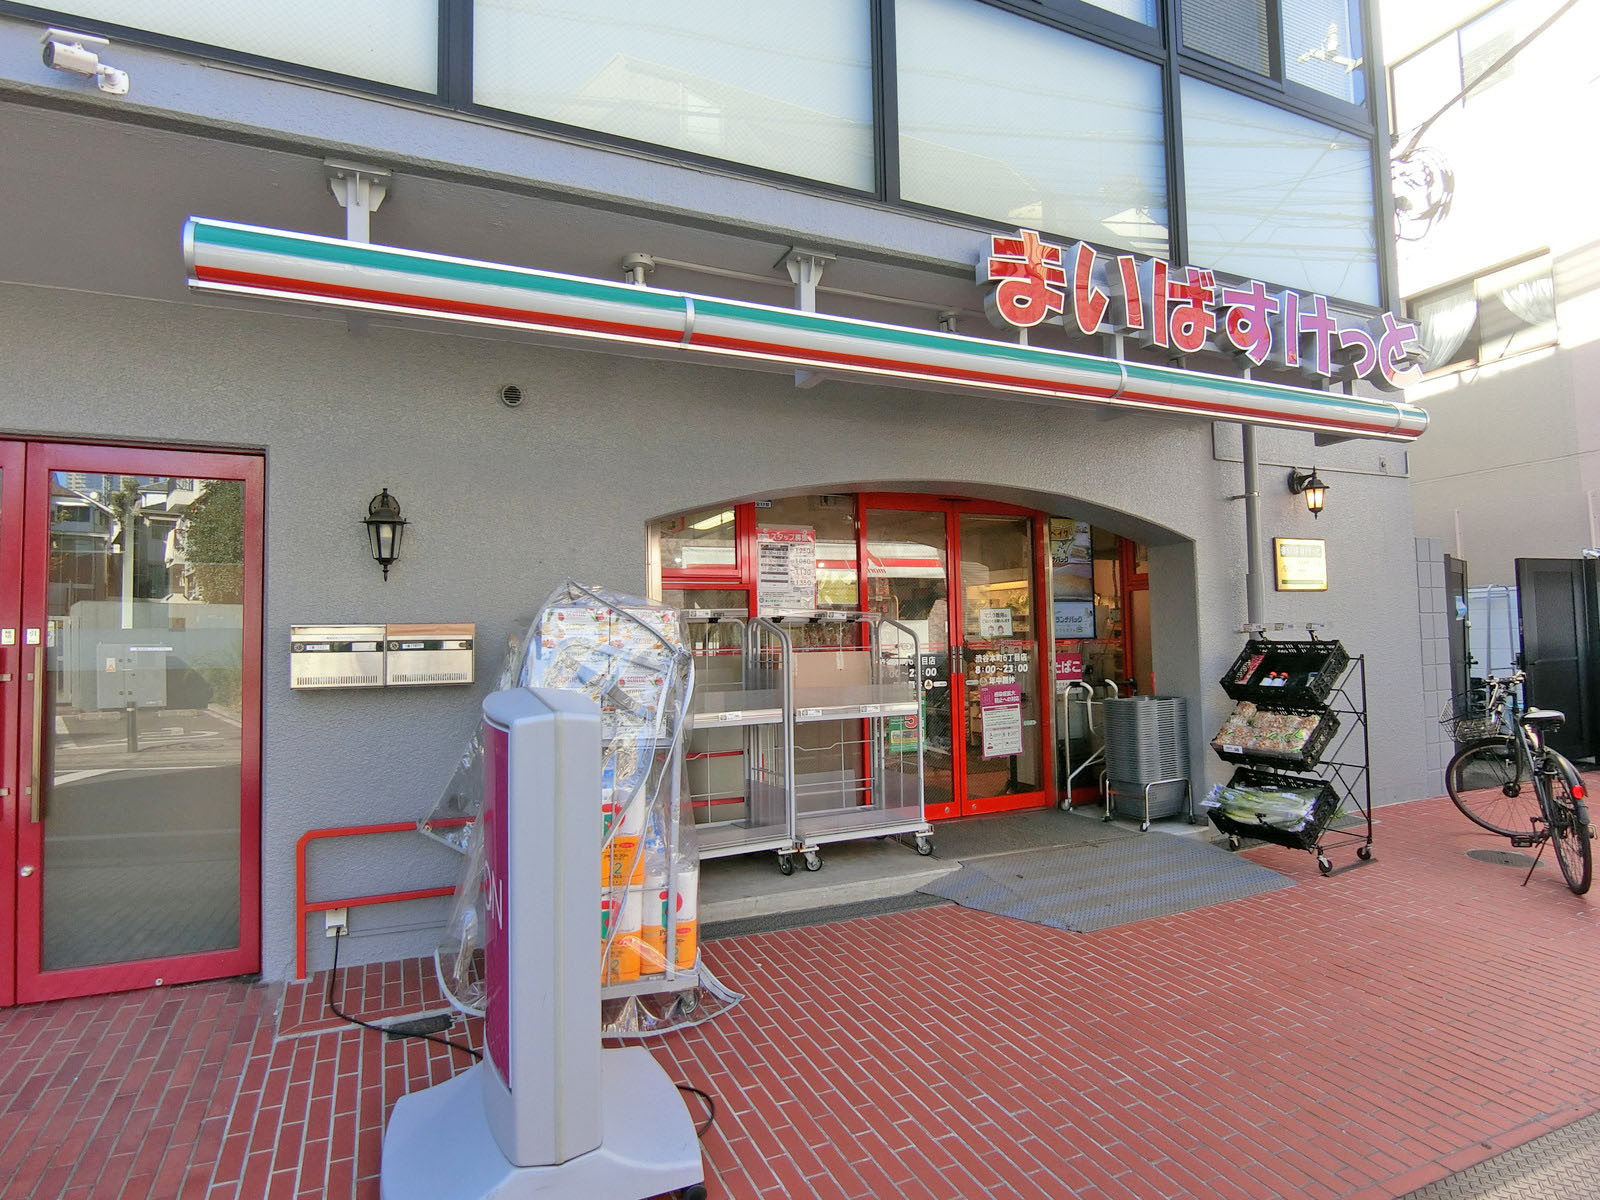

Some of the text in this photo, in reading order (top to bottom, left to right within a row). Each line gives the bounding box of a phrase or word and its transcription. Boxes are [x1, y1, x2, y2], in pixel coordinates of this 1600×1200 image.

[988, 229, 1424, 389] まいばすけっと
[975, 653, 1028, 663] 渋谷本町6丁目店
